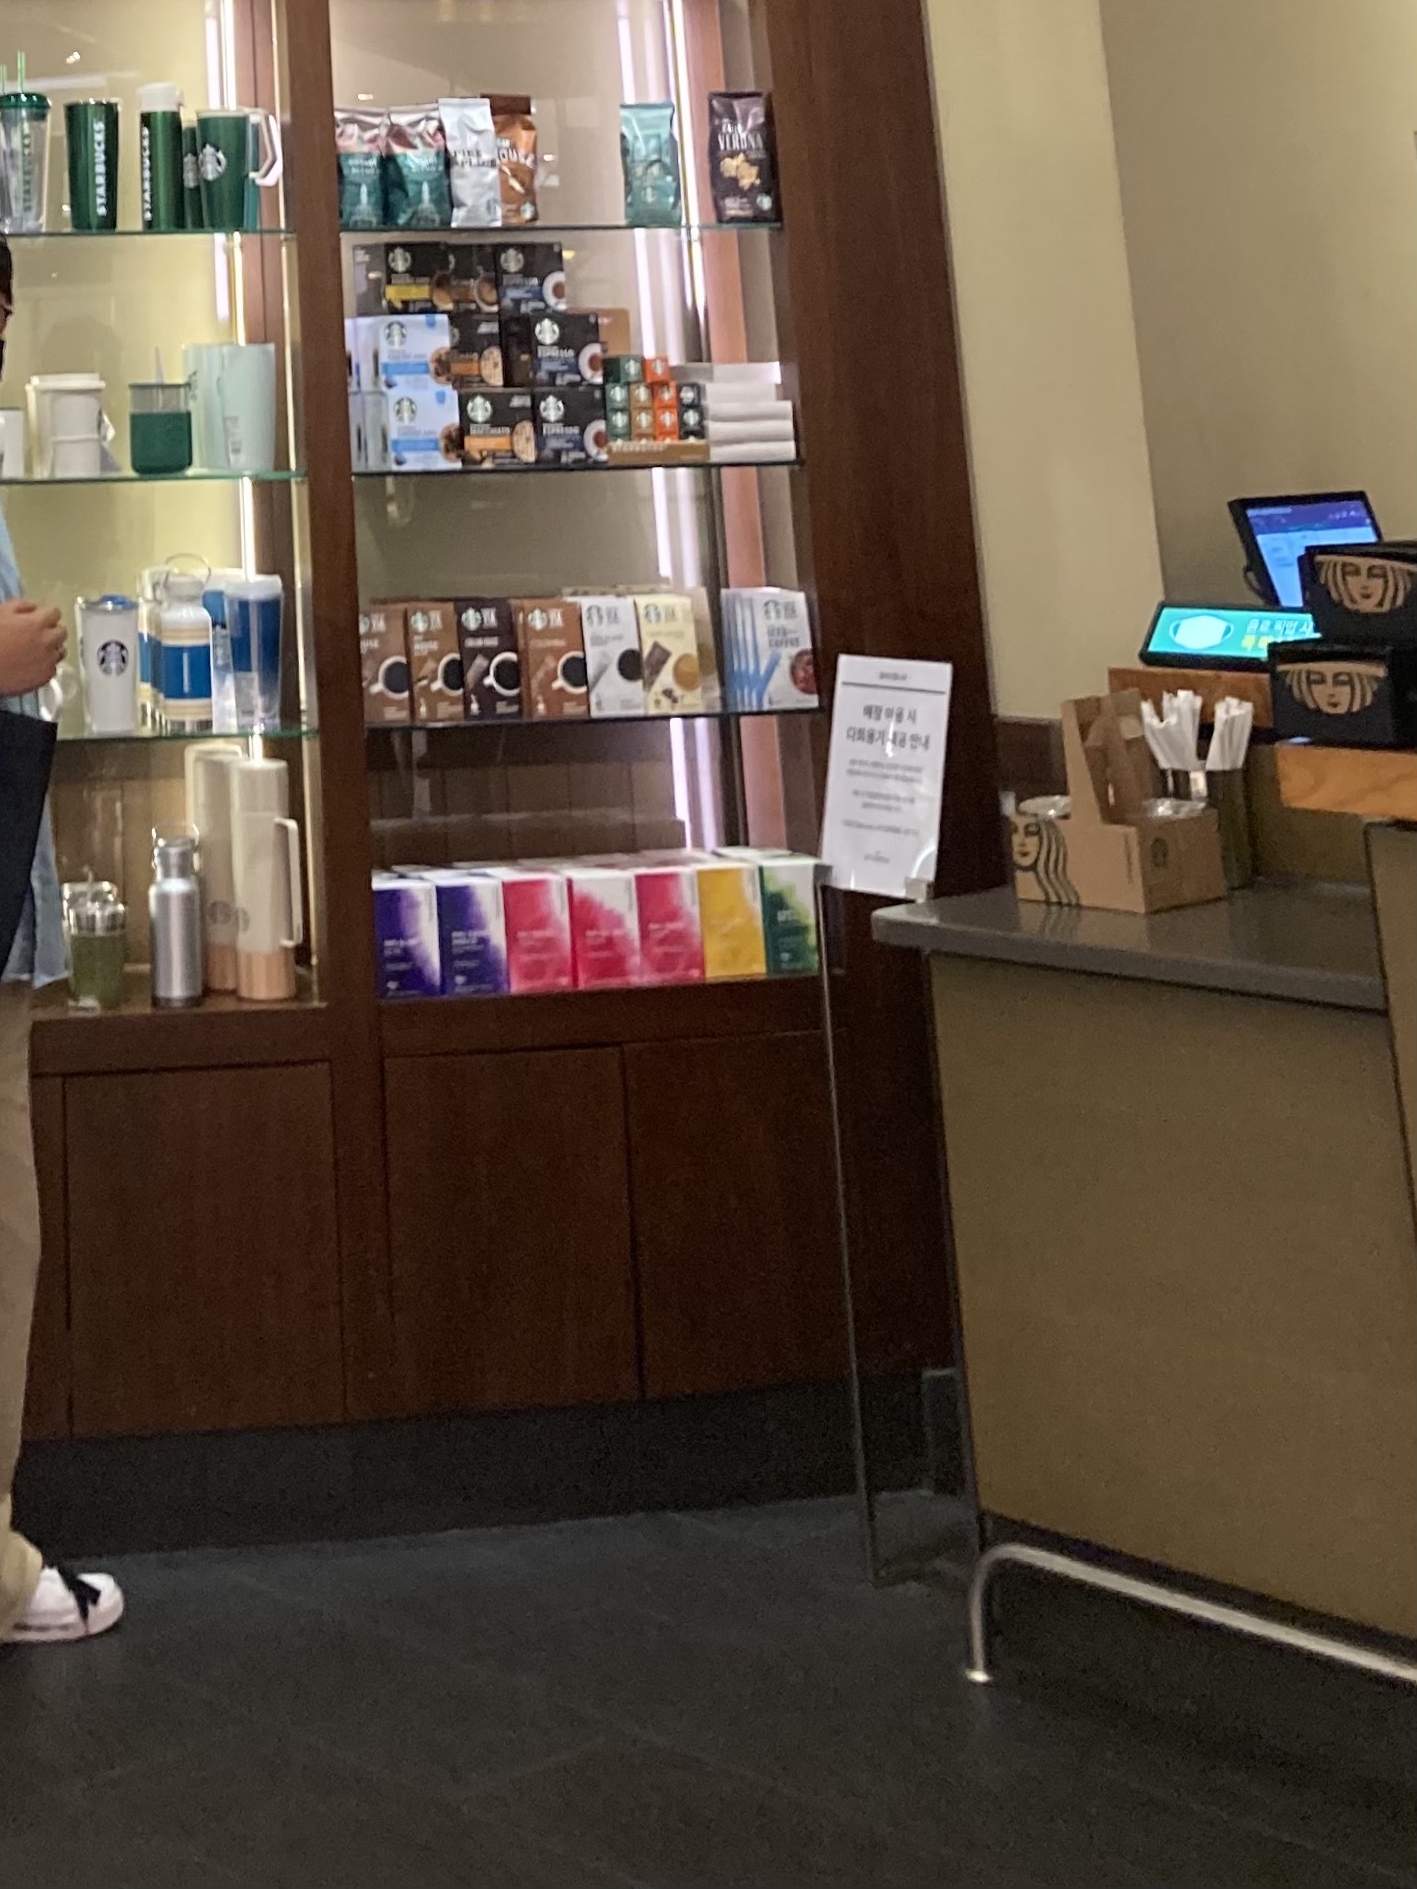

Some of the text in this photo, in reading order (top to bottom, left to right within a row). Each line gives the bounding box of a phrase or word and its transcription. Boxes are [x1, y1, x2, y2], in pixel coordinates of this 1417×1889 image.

[93, 120, 107, 216] STARBUCKS
[1247, 618, 1271, 634] 음료
[1274, 620, 1299, 636] 픽업
[862, 704, 917, 724] 매장 이용 시
[846, 726, 886, 746] 다회용기
[909, 733, 930, 751] 안내
